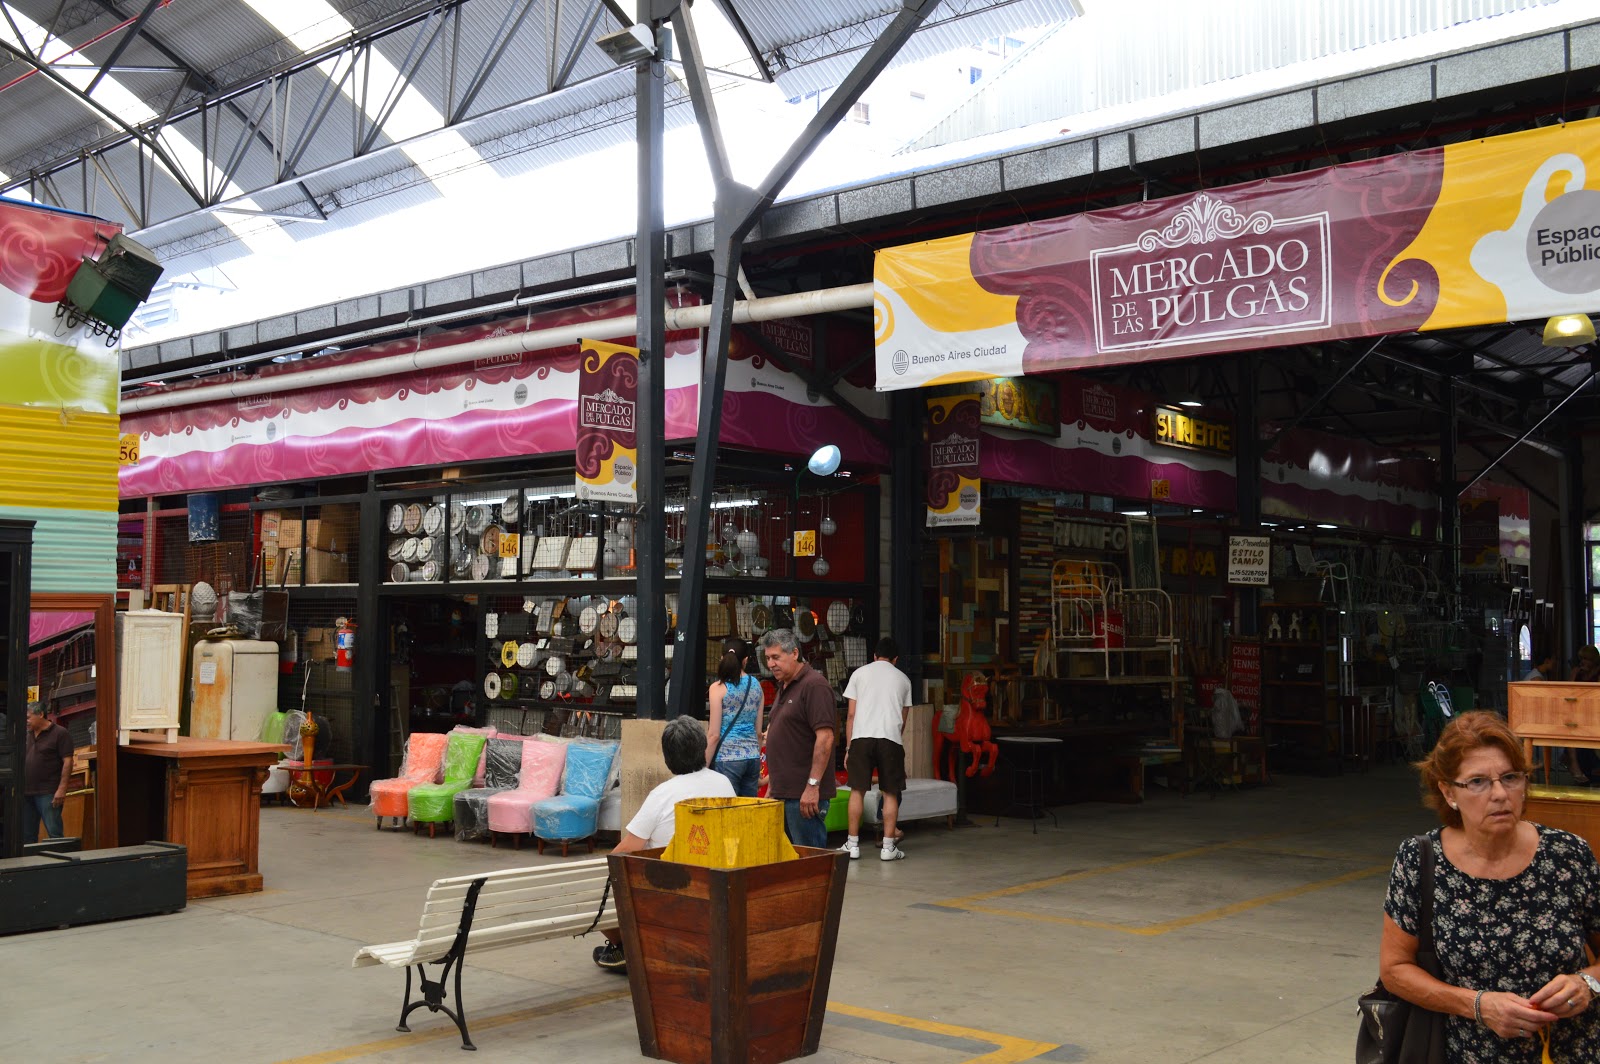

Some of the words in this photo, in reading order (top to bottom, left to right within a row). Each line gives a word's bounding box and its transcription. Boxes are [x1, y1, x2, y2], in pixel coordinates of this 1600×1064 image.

[1109, 239, 1309, 298] MERCADO
[1148, 276, 1309, 330] PULGAS
[1112, 301, 1138, 319] DE
[766, 323, 808, 342] MERCADO
[1113, 317, 1144, 335] LAS
[775, 336, 809, 353] PULGAS
[912, 354, 946, 364] Buenos
[947, 350, 971, 360] Aires
[973, 345, 1007, 357] Ciudad
[586, 401, 631, 416] MERCADO
[595, 413, 631, 427] PULGAS
[934, 444, 975, 455] MERCADO
[942, 453, 975, 463] PULGAS
[1154, 486, 1168, 496] 145
[501, 542, 517, 554] 146
[797, 540, 814, 553] 146
[1232, 549, 1264, 557] ESTILO
[1232, 557, 1264, 566] CAMPO
[1232, 646, 1260, 657] CRICKET
[1232, 659, 1260, 670] TENNIS
[1231, 684, 1259, 696] CIRCUS
